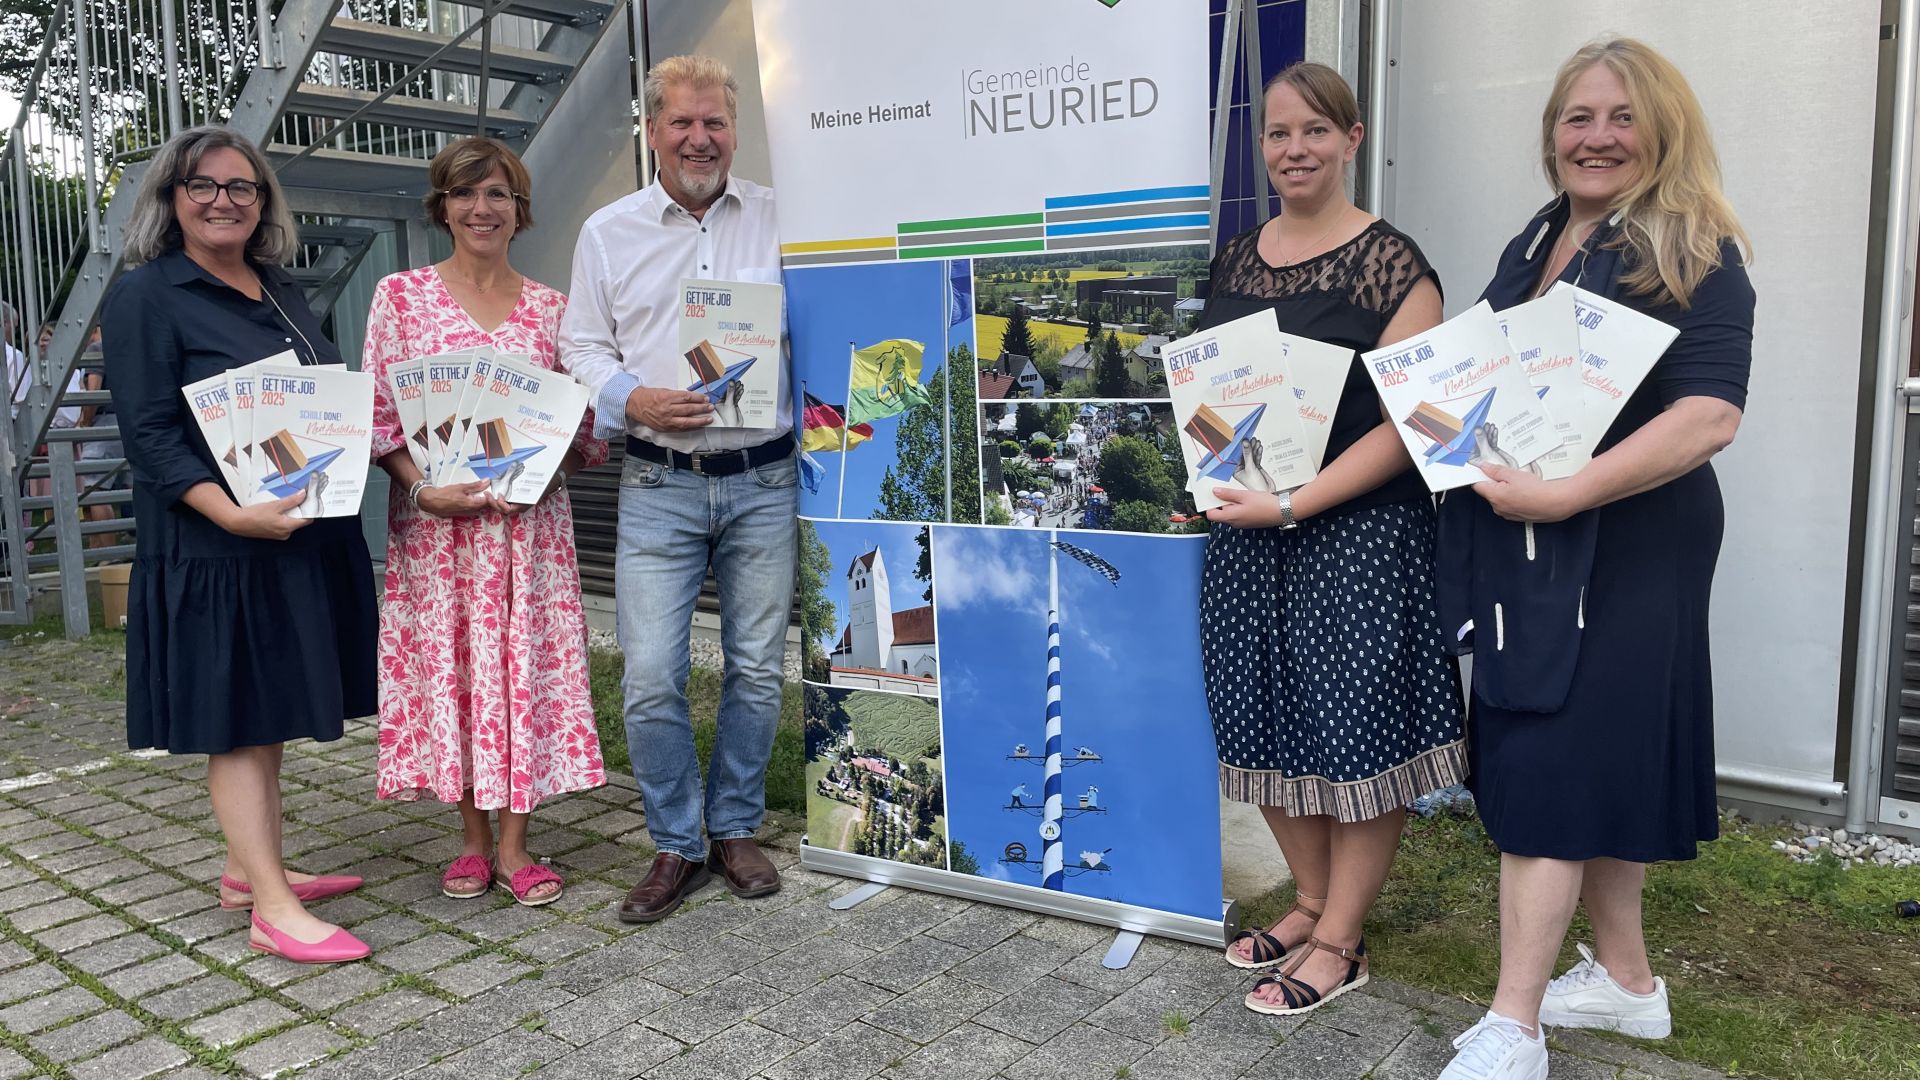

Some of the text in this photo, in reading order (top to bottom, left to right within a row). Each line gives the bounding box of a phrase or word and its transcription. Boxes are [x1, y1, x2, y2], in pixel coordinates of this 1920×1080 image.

[967, 56, 1090, 95] Gemeinde
[811, 100, 931, 130] Meine Heimat
[970, 77, 1159, 137] NEURIED
[686, 291, 731, 306] GET THE JOB
[685, 304, 705, 318] 2025
[739, 322, 753, 331] DONE!
[1579, 311, 1604, 330] JOB
[1169, 351, 1185, 371] GET
[1183, 348, 1202, 365] THE
[1202, 342, 1219, 361] JOB
[1375, 359, 1394, 376] GET
[1393, 353, 1415, 371] THE
[1415, 344, 1435, 362] JOB
[1521, 347, 1542, 362] DONE!
[1585, 353, 1608, 370] DONE!
[430, 367, 446, 379] GET
[446, 367, 460, 379] THE
[476, 361, 491, 379] GET
[1172, 366, 1195, 386] 2025
[1211, 365, 1253, 386] SCHULE DONE!
[1381, 369, 1409, 388] 2025
[1429, 357, 1476, 385] SCHULE DONE!
[1445, 355, 1510, 397] Next Ausbildung
[235, 382, 252, 396] GET
[262, 378, 315, 394] GET THE JOB
[396, 374, 412, 388] GET
[431, 381, 451, 393] 2025
[490, 380, 511, 397] 2025
[494, 367, 509, 382] GET
[508, 372, 524, 389] THE
[523, 379, 540, 394] JOB
[1222, 373, 1284, 400] Next Ausbildung
[195, 393, 213, 409] GET
[261, 392, 285, 406] 2025
[400, 385, 421, 400] 2025
[201, 404, 226, 422] 2025
[300, 410, 342, 422] SCHULE DONE!
